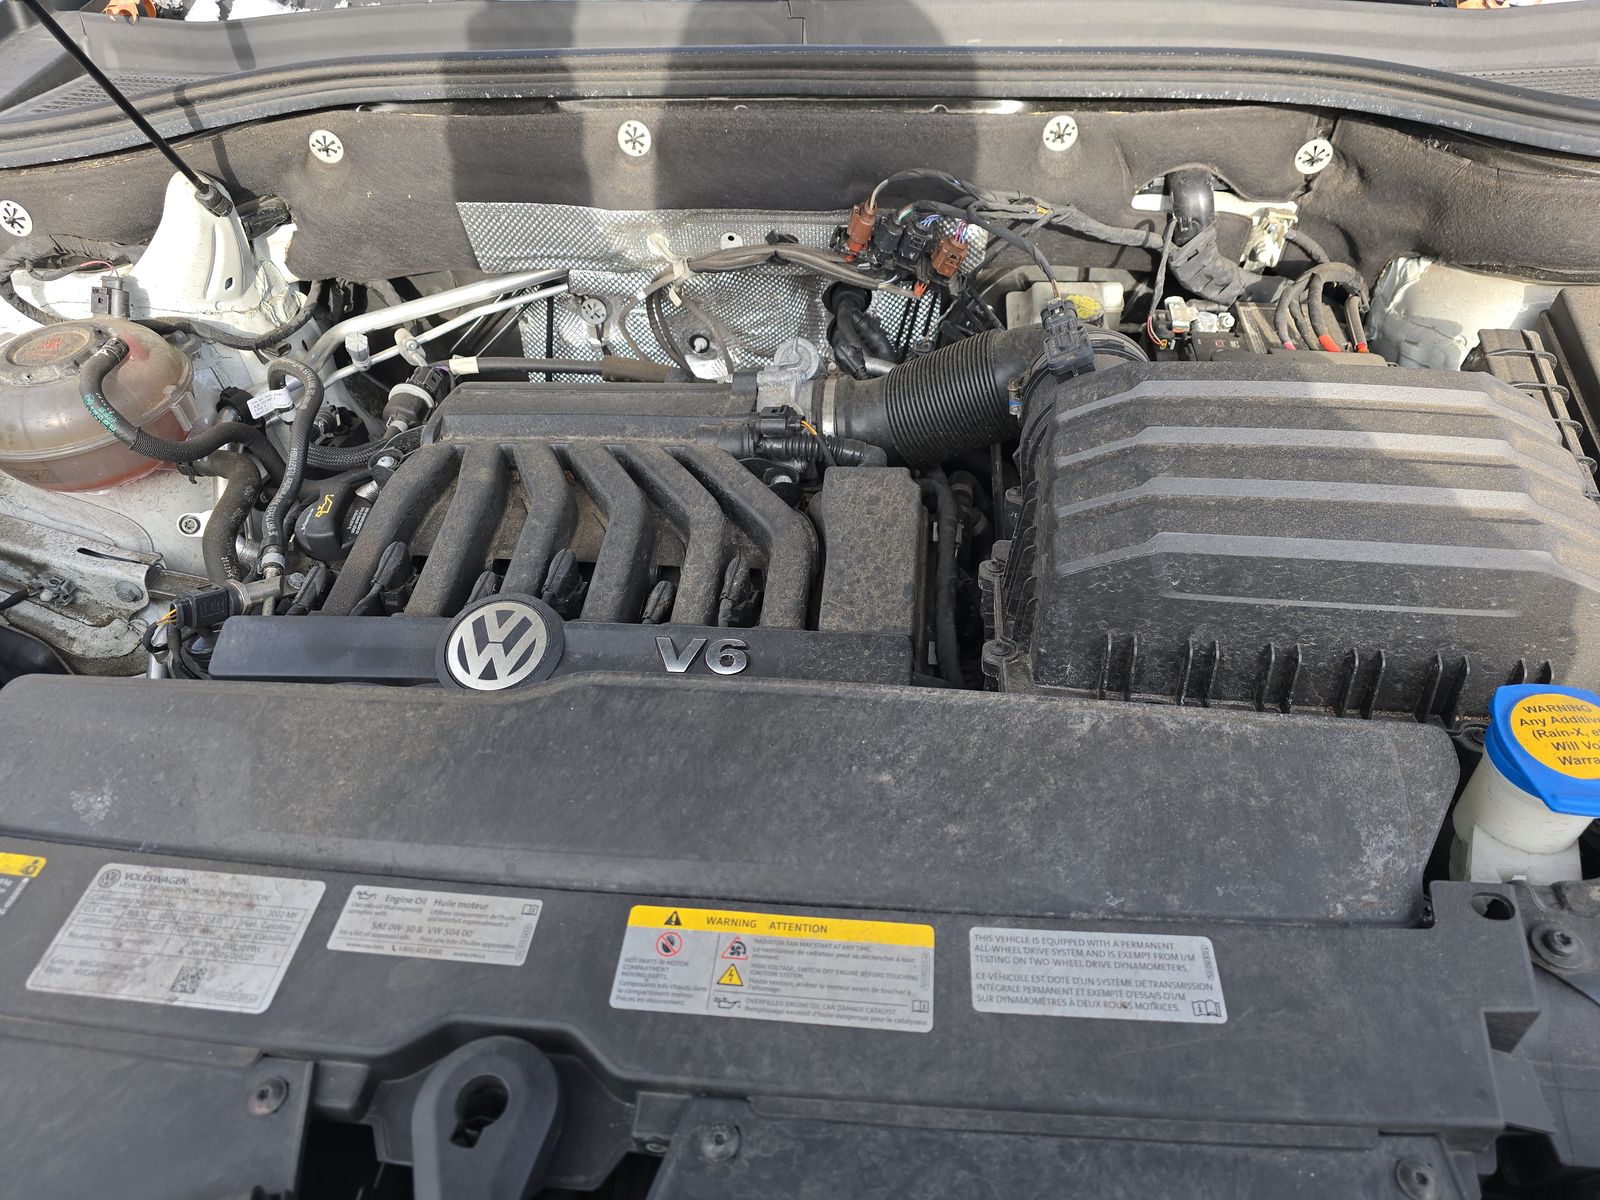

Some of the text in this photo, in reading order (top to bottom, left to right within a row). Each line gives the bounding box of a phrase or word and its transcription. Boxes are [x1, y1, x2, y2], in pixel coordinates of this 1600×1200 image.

[655, 636, 749, 675] V6
[1523, 704, 1592, 714] WARNING
[1520, 718, 1546, 727] Any
[1532, 728, 1590, 741] (Rain-X,
[1551, 740, 1600, 751] Will Vo
[1558, 755, 1600, 766] Warra
[122, 872, 189, 885] VOLKSWAGEN
[383, 894, 428, 905] Engine Oil
[432, 898, 489, 910] Huile moteur
[370, 921, 387, 930] SAE
[415, 925, 424, 933] &
[426, 926, 443, 935] VW
[442, 927, 461, 936] 504
[460, 928, 474, 937] 00
[704, 915, 828, 934] WARNING ATTENTION
[974, 933, 1175, 950] THIS VEHICLE IS EQUIPPED WITH A PERMANENT
[974, 943, 1196, 961] ALL-WHEEL DRIVE SYSTEM AND IS EXEMPT FROM I/M
[975, 954, 1011, 964] TESTING
[1012, 956, 1026, 964] ON
[1028, 957, 1085, 967] TWO-WHEEL
[1085, 959, 1112, 968] DRIVE
[975, 972, 986, 980] CE
[1030, 974, 1045, 983] EST
[1072, 976, 1095, 985] D'UN
[1134, 979, 1145, 987] DE
[1144, 980, 1213, 991] TRANSMISSION
[1022, 985, 1074, 995] PERMANENT
[976, 994, 993, 1002] SUR
[1076, 999, 1101, 1008] DEUX
